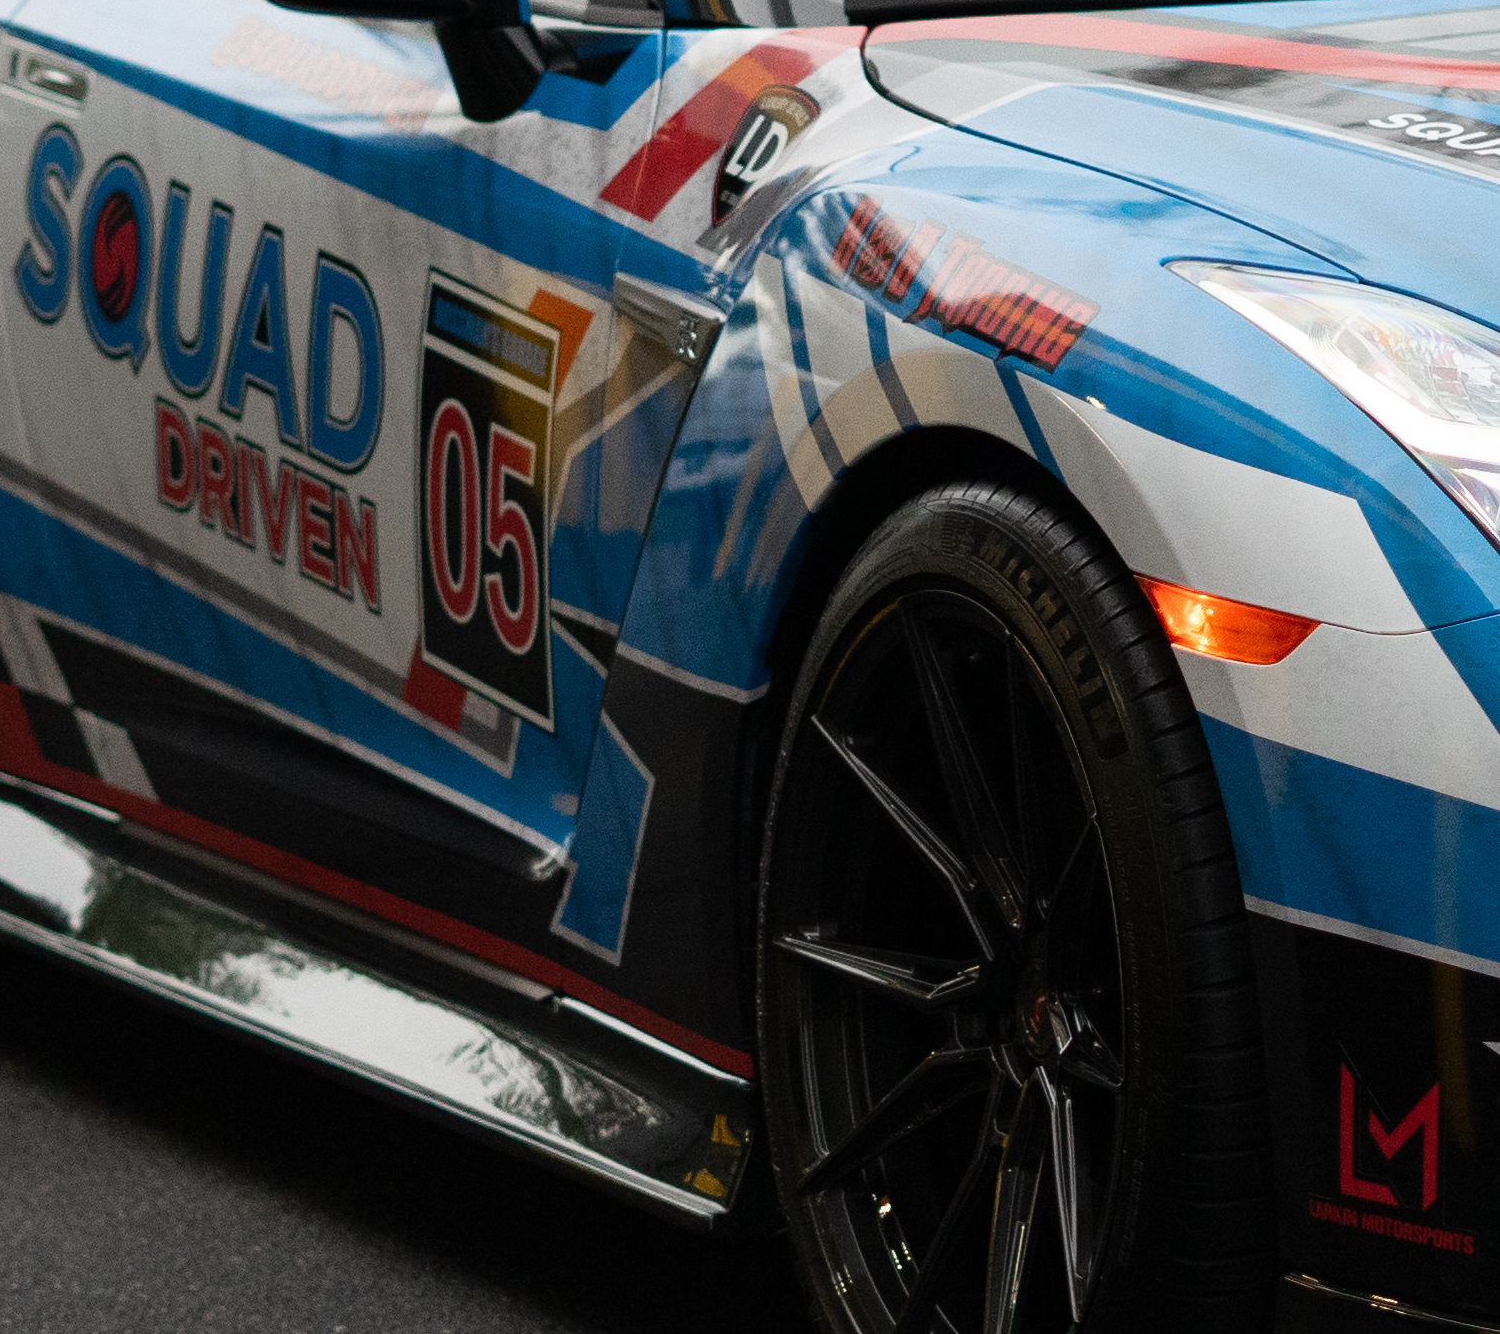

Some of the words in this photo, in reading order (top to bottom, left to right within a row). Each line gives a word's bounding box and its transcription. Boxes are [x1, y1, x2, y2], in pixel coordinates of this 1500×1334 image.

[14, 121, 387, 475] SQUAD
[155, 394, 383, 615] DRIVEN
[426, 397, 540, 655] 05
[979, 532, 1121, 741] MICHELIN
[1360, 1212, 1475, 1255] MOTORSPORTS
